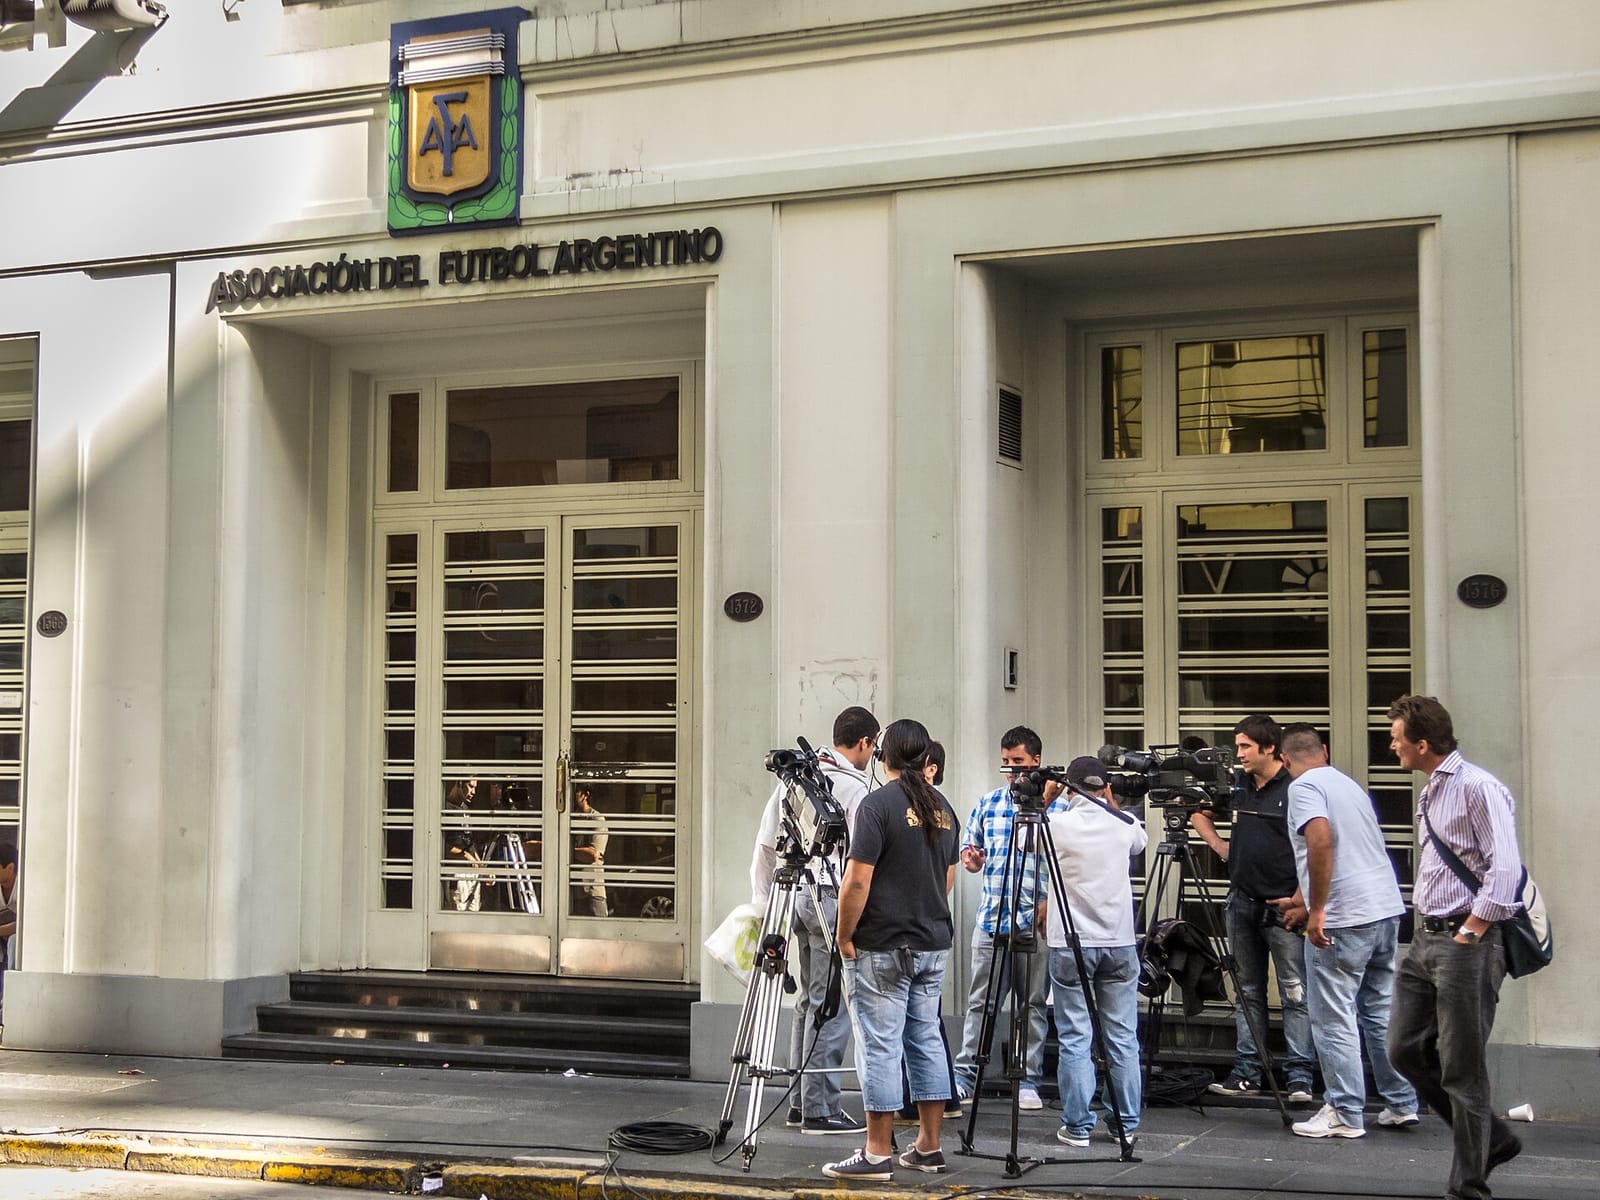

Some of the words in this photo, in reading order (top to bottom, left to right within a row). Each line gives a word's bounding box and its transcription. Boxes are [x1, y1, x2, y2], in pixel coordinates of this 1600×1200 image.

[211, 253, 372, 303] ASOCIACIÓN
[378, 254, 429, 289] DEL
[438, 244, 549, 285] FUTBOL
[553, 226, 723, 275] ARGENTINO
